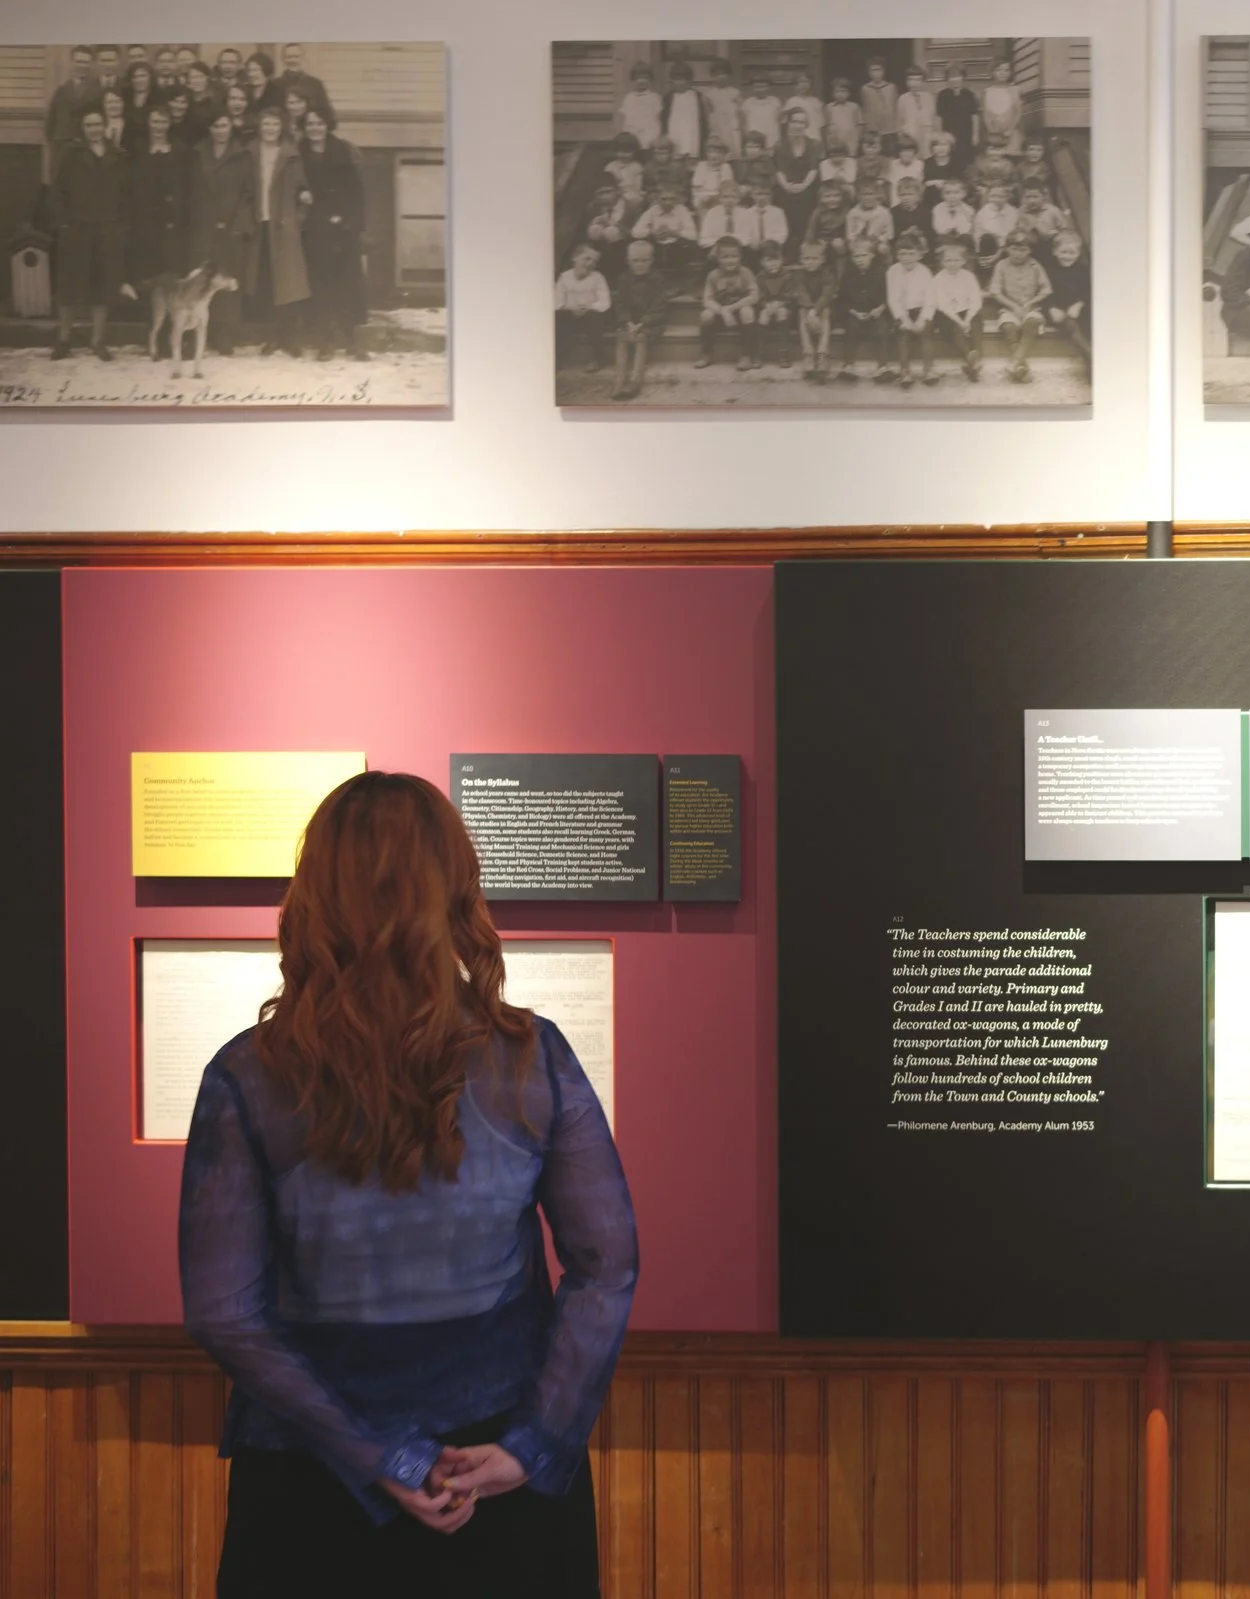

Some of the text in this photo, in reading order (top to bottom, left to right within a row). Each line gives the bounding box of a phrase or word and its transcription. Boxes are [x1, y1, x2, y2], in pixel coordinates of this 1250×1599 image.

[461, 778, 520, 787] On the Syllabus
[917, 928, 971, 940] Teachers
[972, 928, 1009, 942] spend
[1010, 928, 1087, 940] considerable
[892, 946, 1077, 960] time in costuming the children,
[892, 964, 1092, 978] which gives the parade additional
[892, 982, 1085, 996] colour and variety. Primary and
[893, 1000, 1104, 1014] Grades I and II are hauled in pretty,
[892, 1018, 1081, 1032] decorated ox-wagons, a mode of
[893, 1036, 1109, 1050] transportation for which Lunenburg
[892, 1054, 1098, 1068] is famous. Behind these ox-wagons
[891, 1072, 1092, 1086] follow hundreds of school children
[891, 1090, 922, 1104] from
[924, 1090, 944, 1102] the
[946, 1090, 979, 1102] Town
[981, 1090, 1005, 1102] and
[1006, 1090, 1052, 1104] County
[950, 1121, 996, 1132] Arenburg,
[998, 1121, 1043, 1132] Academy
[1044, 1121, 1069, 1130] Alum
[1072, 1121, 1095, 1131] 1953
